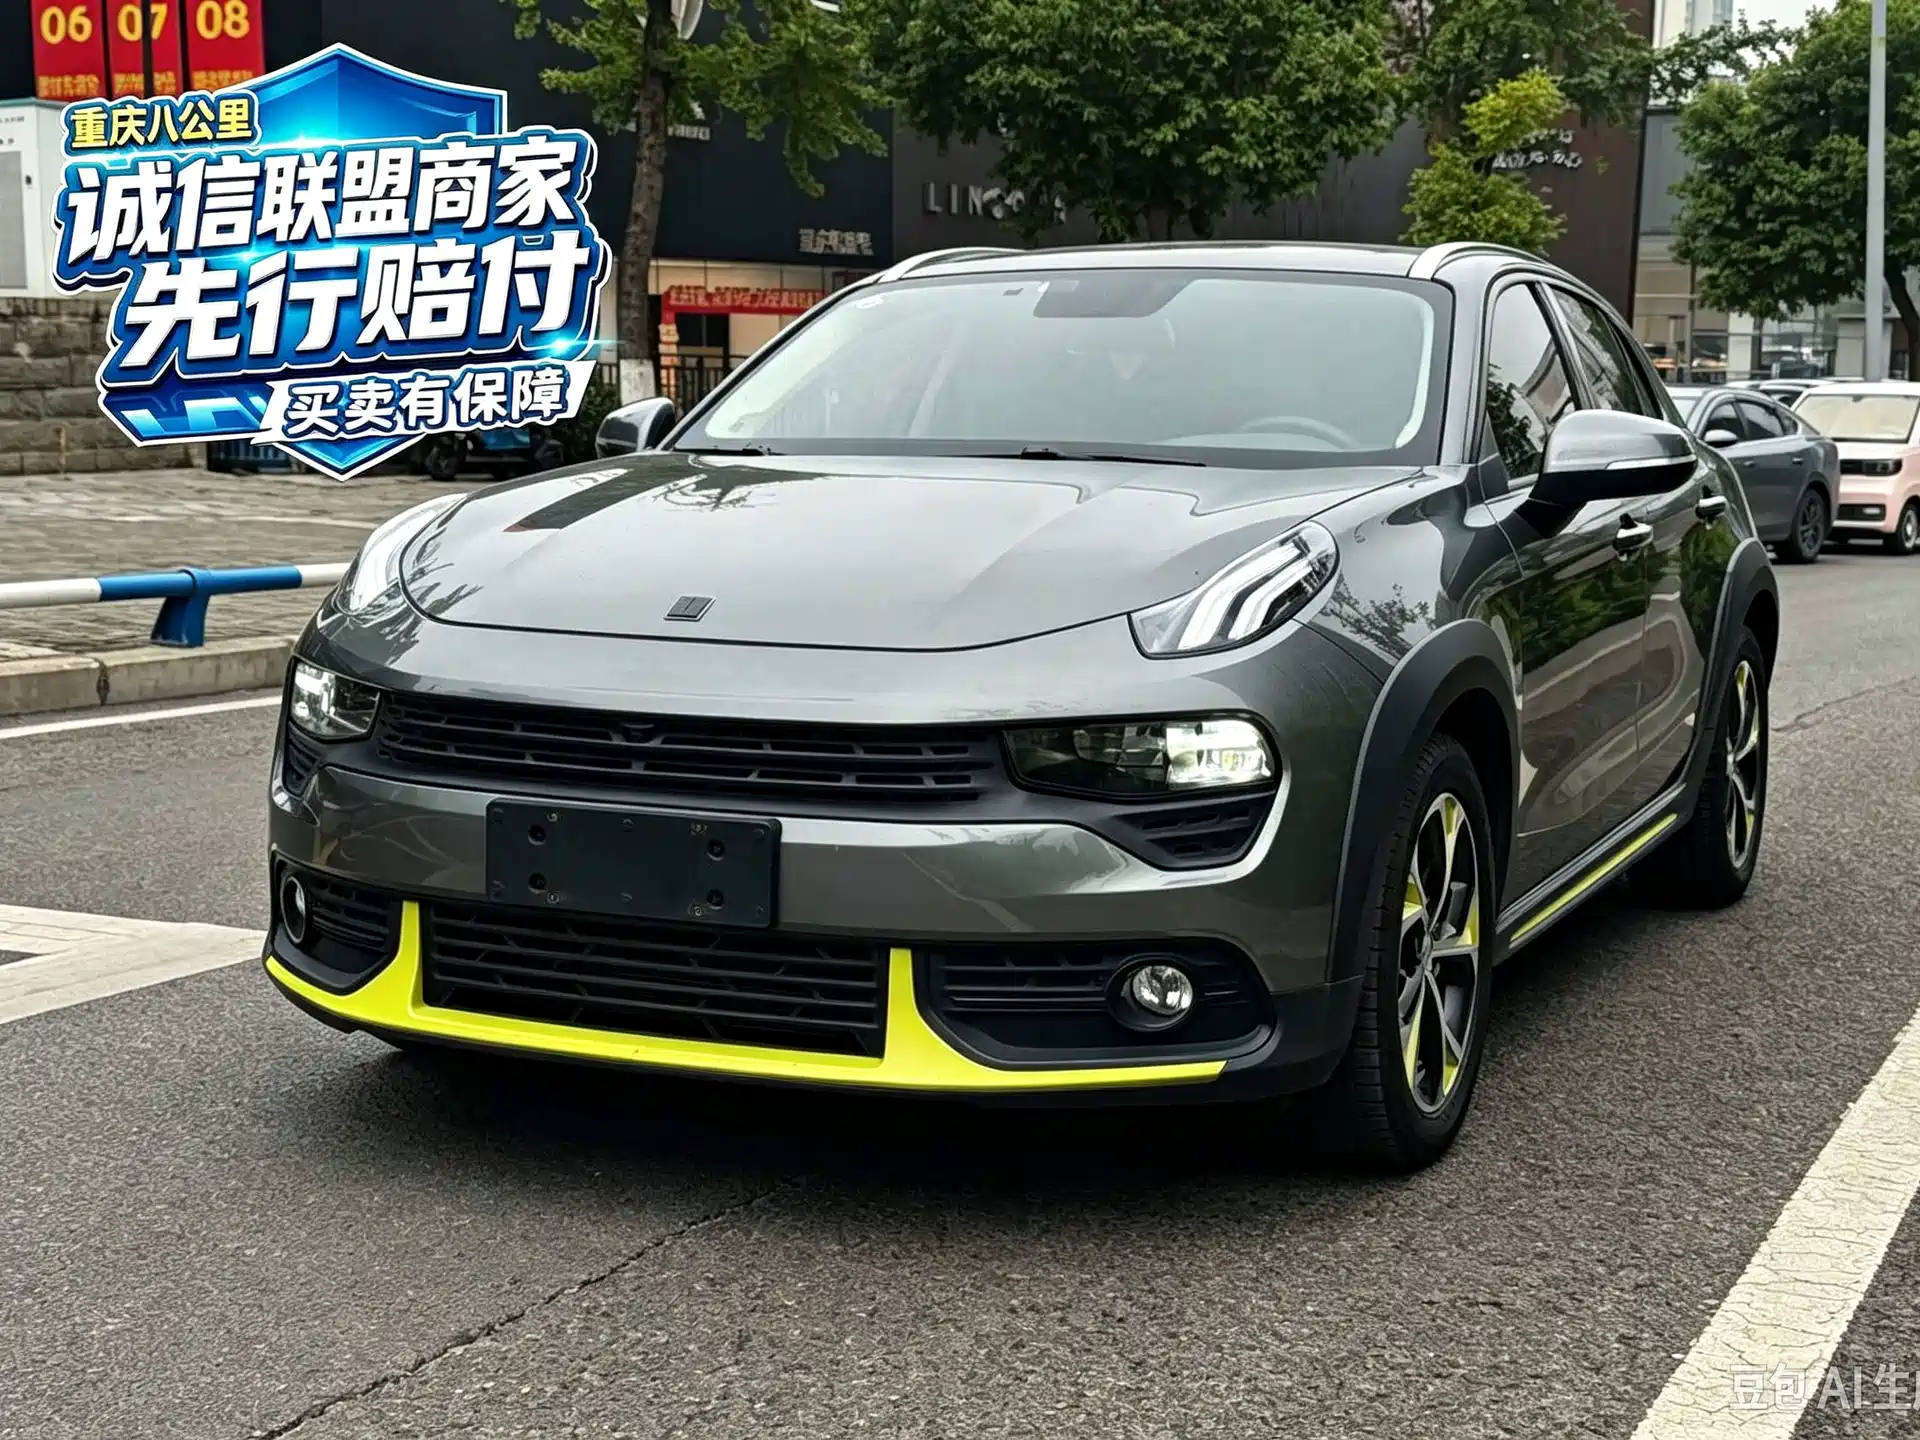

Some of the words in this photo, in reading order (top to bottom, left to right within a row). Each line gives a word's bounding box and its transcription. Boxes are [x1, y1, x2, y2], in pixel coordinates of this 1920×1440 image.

[40, 6, 92, 44] 06
[117, 4, 167, 42] 07
[195, 0, 250, 39] 08
